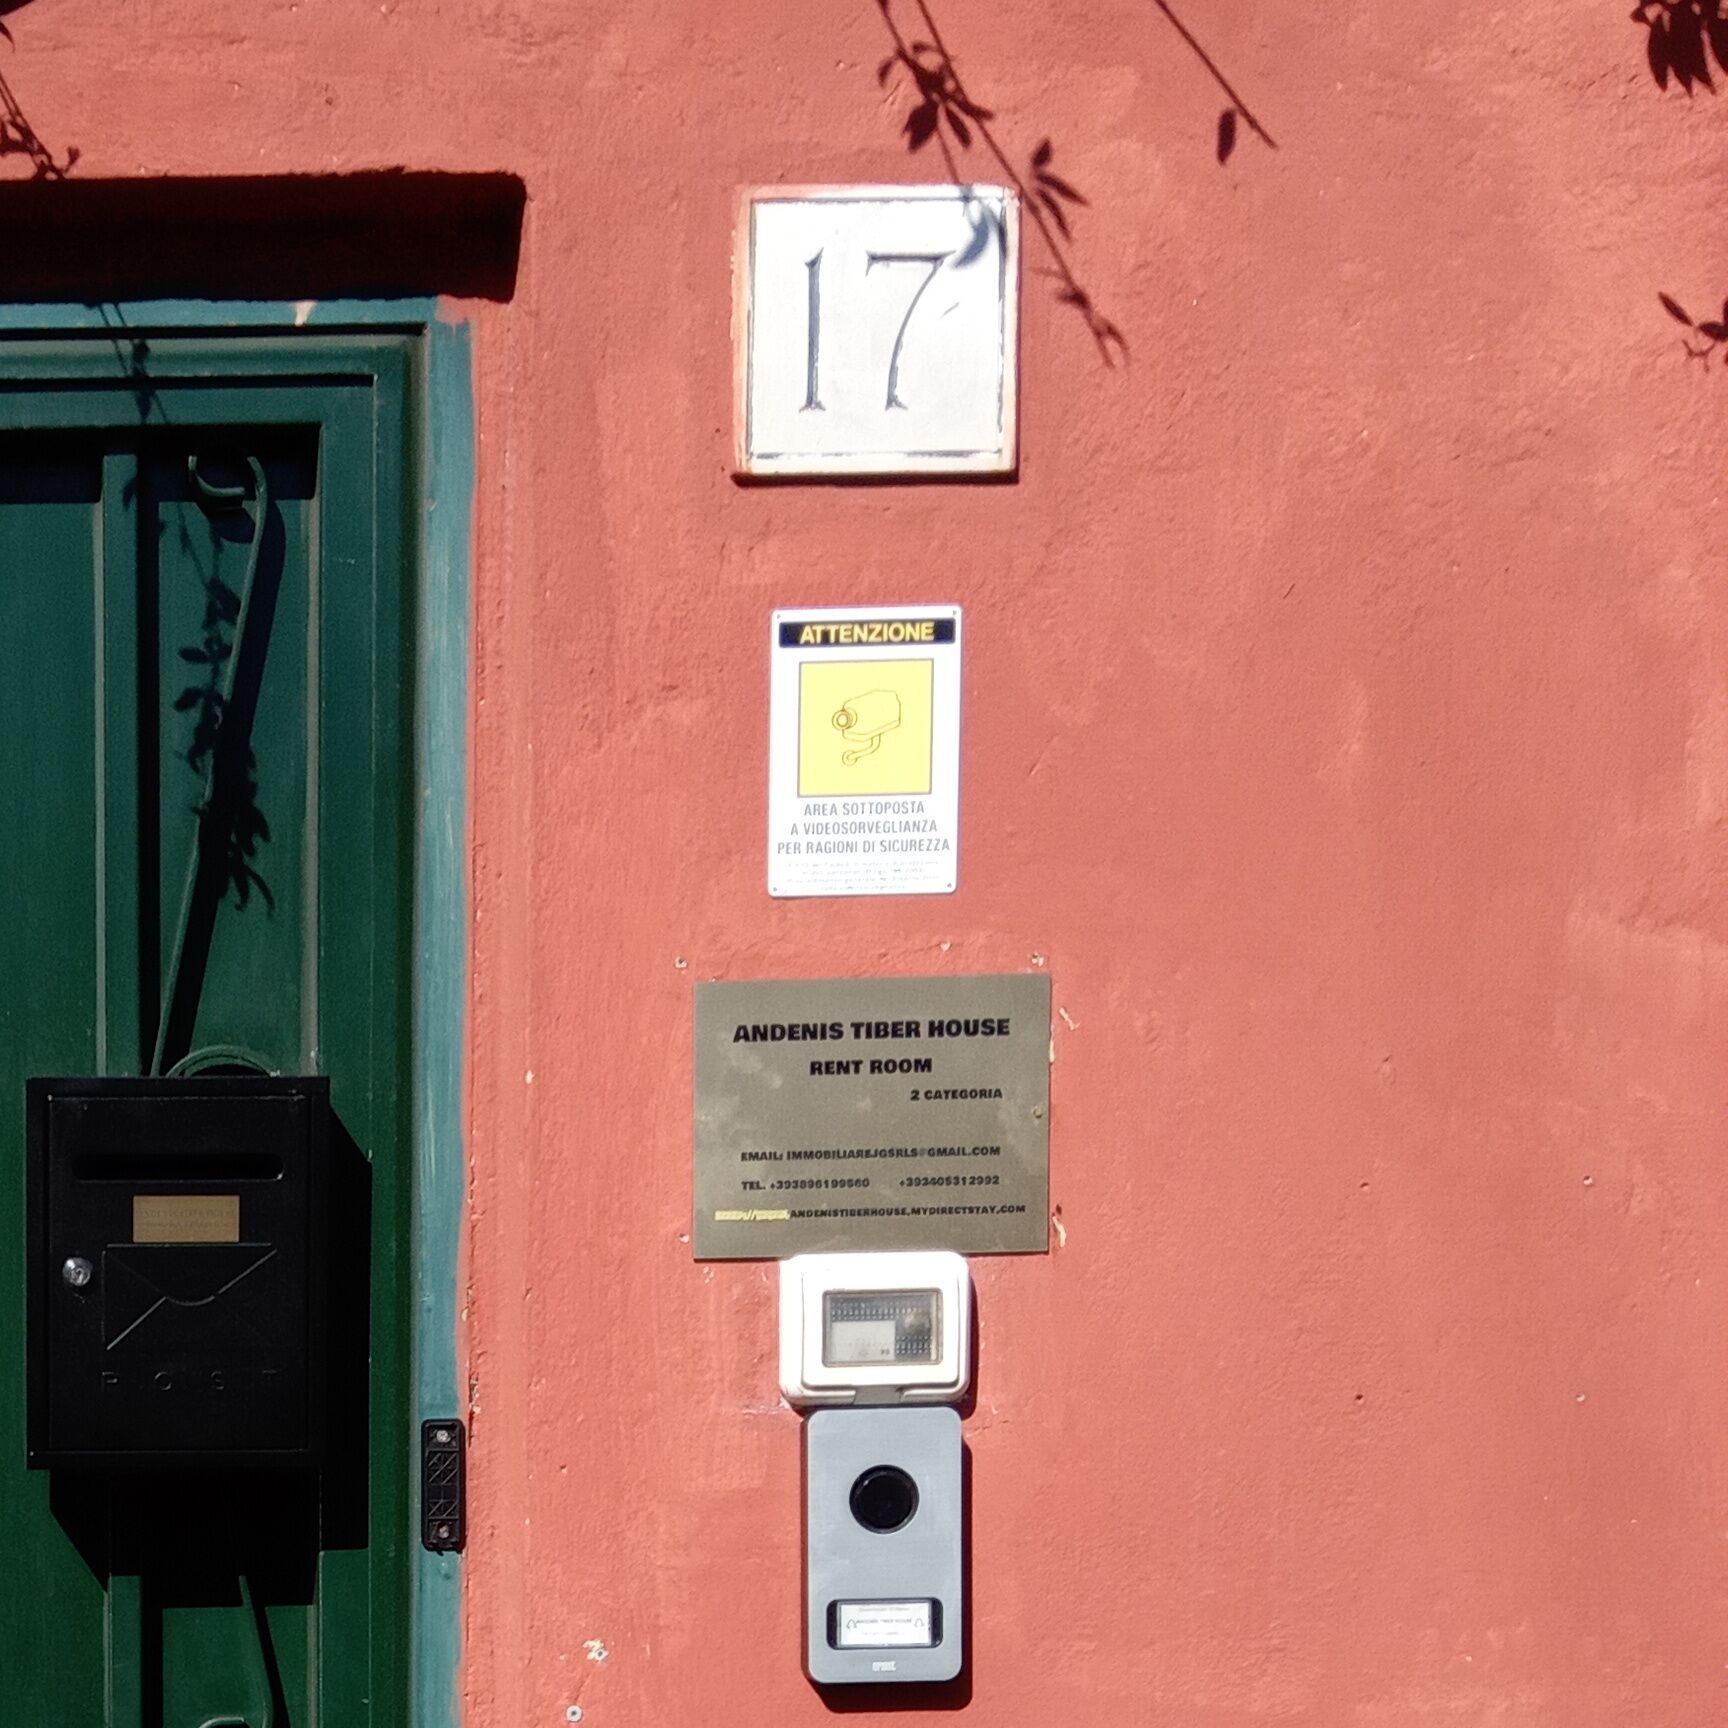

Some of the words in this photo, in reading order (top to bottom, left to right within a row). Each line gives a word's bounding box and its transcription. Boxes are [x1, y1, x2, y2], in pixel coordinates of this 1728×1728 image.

[798, 247, 957, 414] 17
[799, 621, 935, 644] ATTENZIONE
[803, 803, 838, 817] AREA
[842, 801, 925, 816] SOTTOPOSTA
[790, 823, 799, 836] A
[803, 820, 938, 835] VIDEOSORVEGLIANZA
[777, 841, 802, 855] PER
[806, 840, 858, 854] RAGIONI
[862, 840, 875, 853] DI
[879, 838, 950, 853] SICUREZZA
[733, 1021, 844, 1043] ANDENIS
[850, 1020, 921, 1040] TIBER
[927, 1018, 1010, 1038] HOUSE
[809, 1060, 864, 1076] RENT
[869, 1058, 932, 1074] ROOM
[910, 1089, 920, 1101] 2
[924, 1088, 1003, 1101] CATEGORIA
[740, 1151, 784, 1162] EMAIL:
[741, 1181, 766, 1191] TEL.
